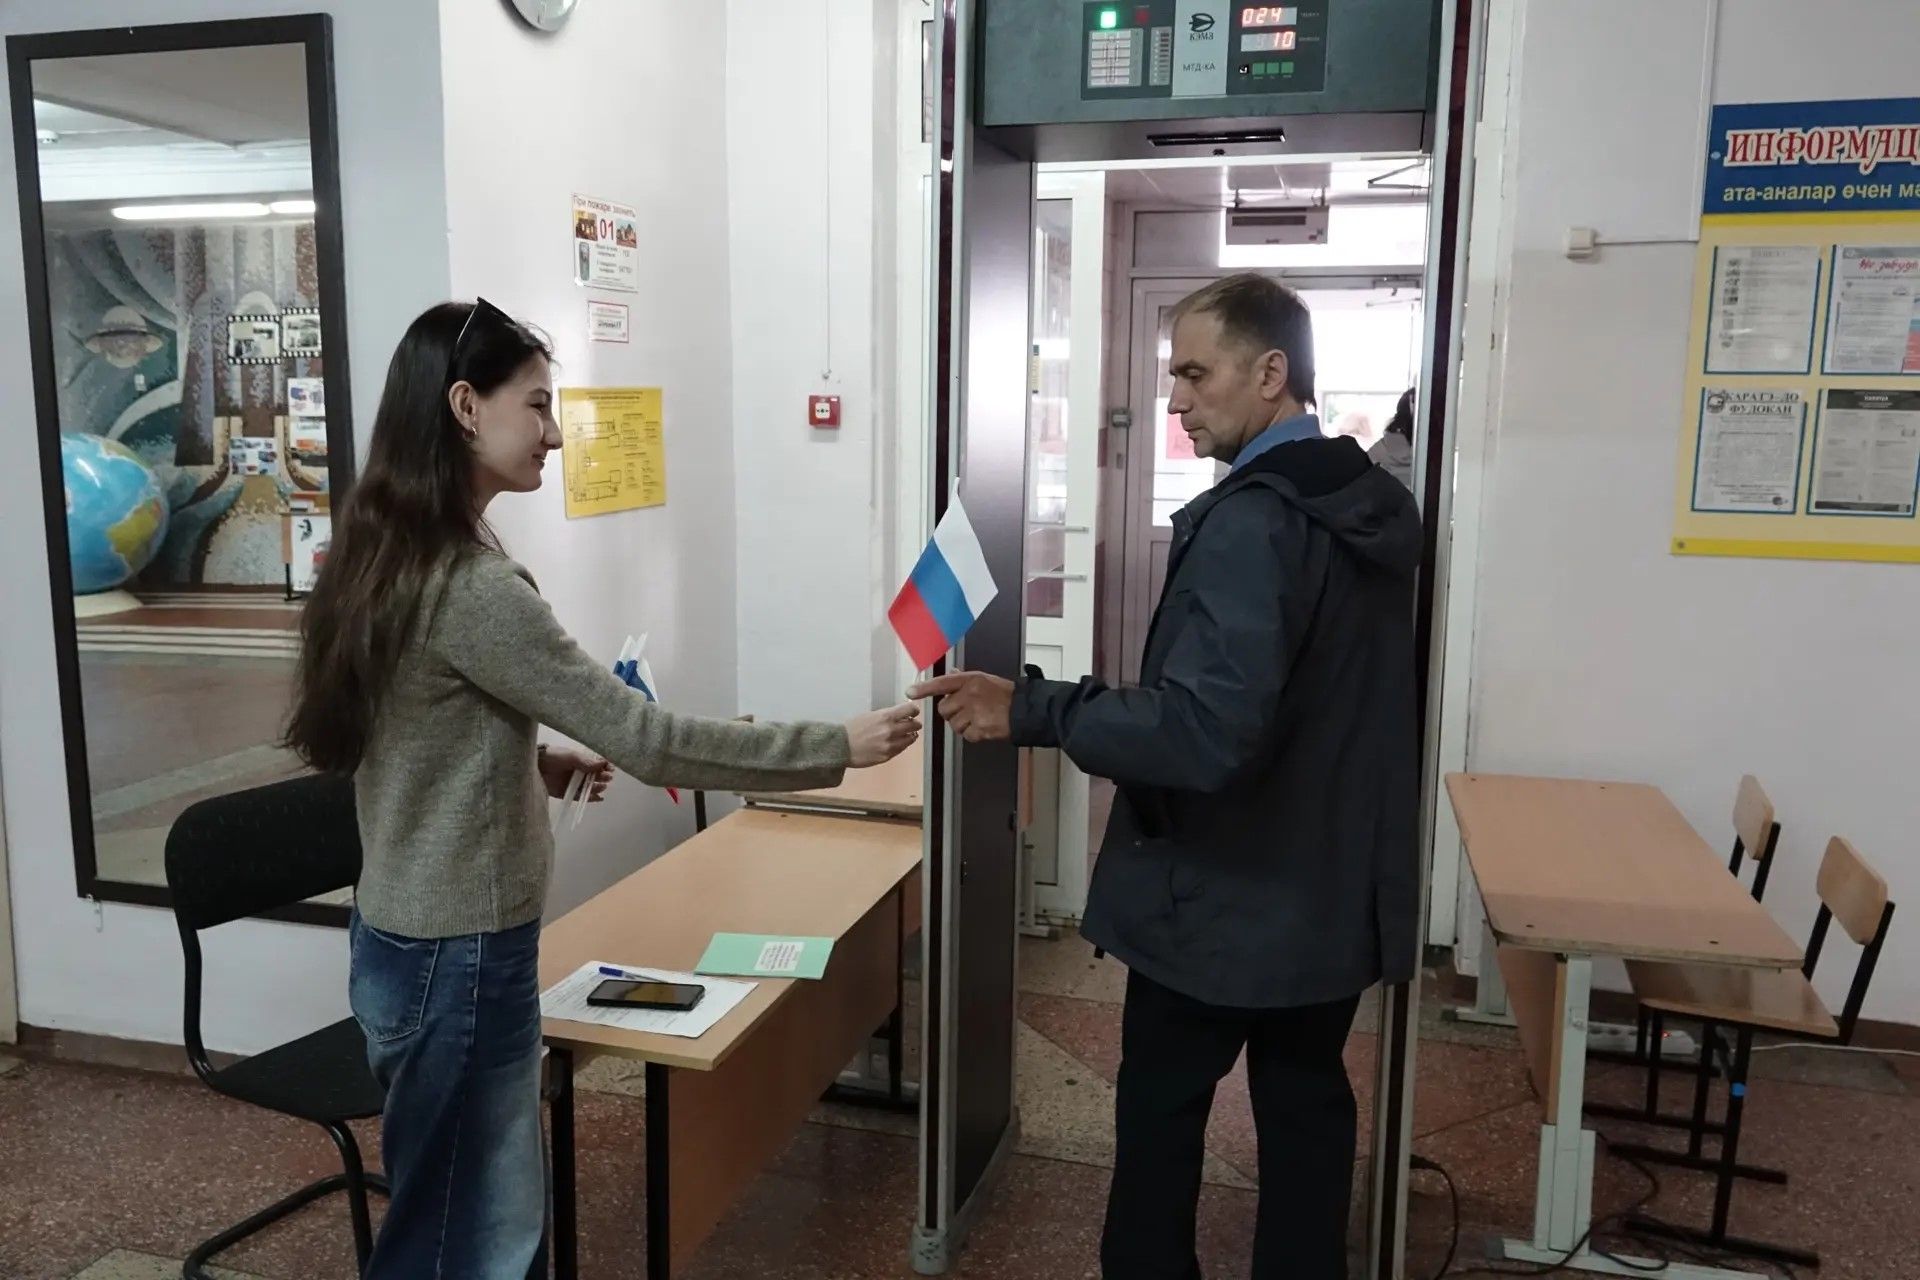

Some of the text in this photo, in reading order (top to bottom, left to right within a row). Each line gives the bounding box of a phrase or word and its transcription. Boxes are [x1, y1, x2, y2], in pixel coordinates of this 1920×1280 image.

[1242, 7, 1282, 24] 024
[1273, 31, 1294, 48] 10
[1723, 184, 1836, 203] ата-аналар
[1842, 183, 1892, 199] өчен
[599, 218, 615, 241] 01
